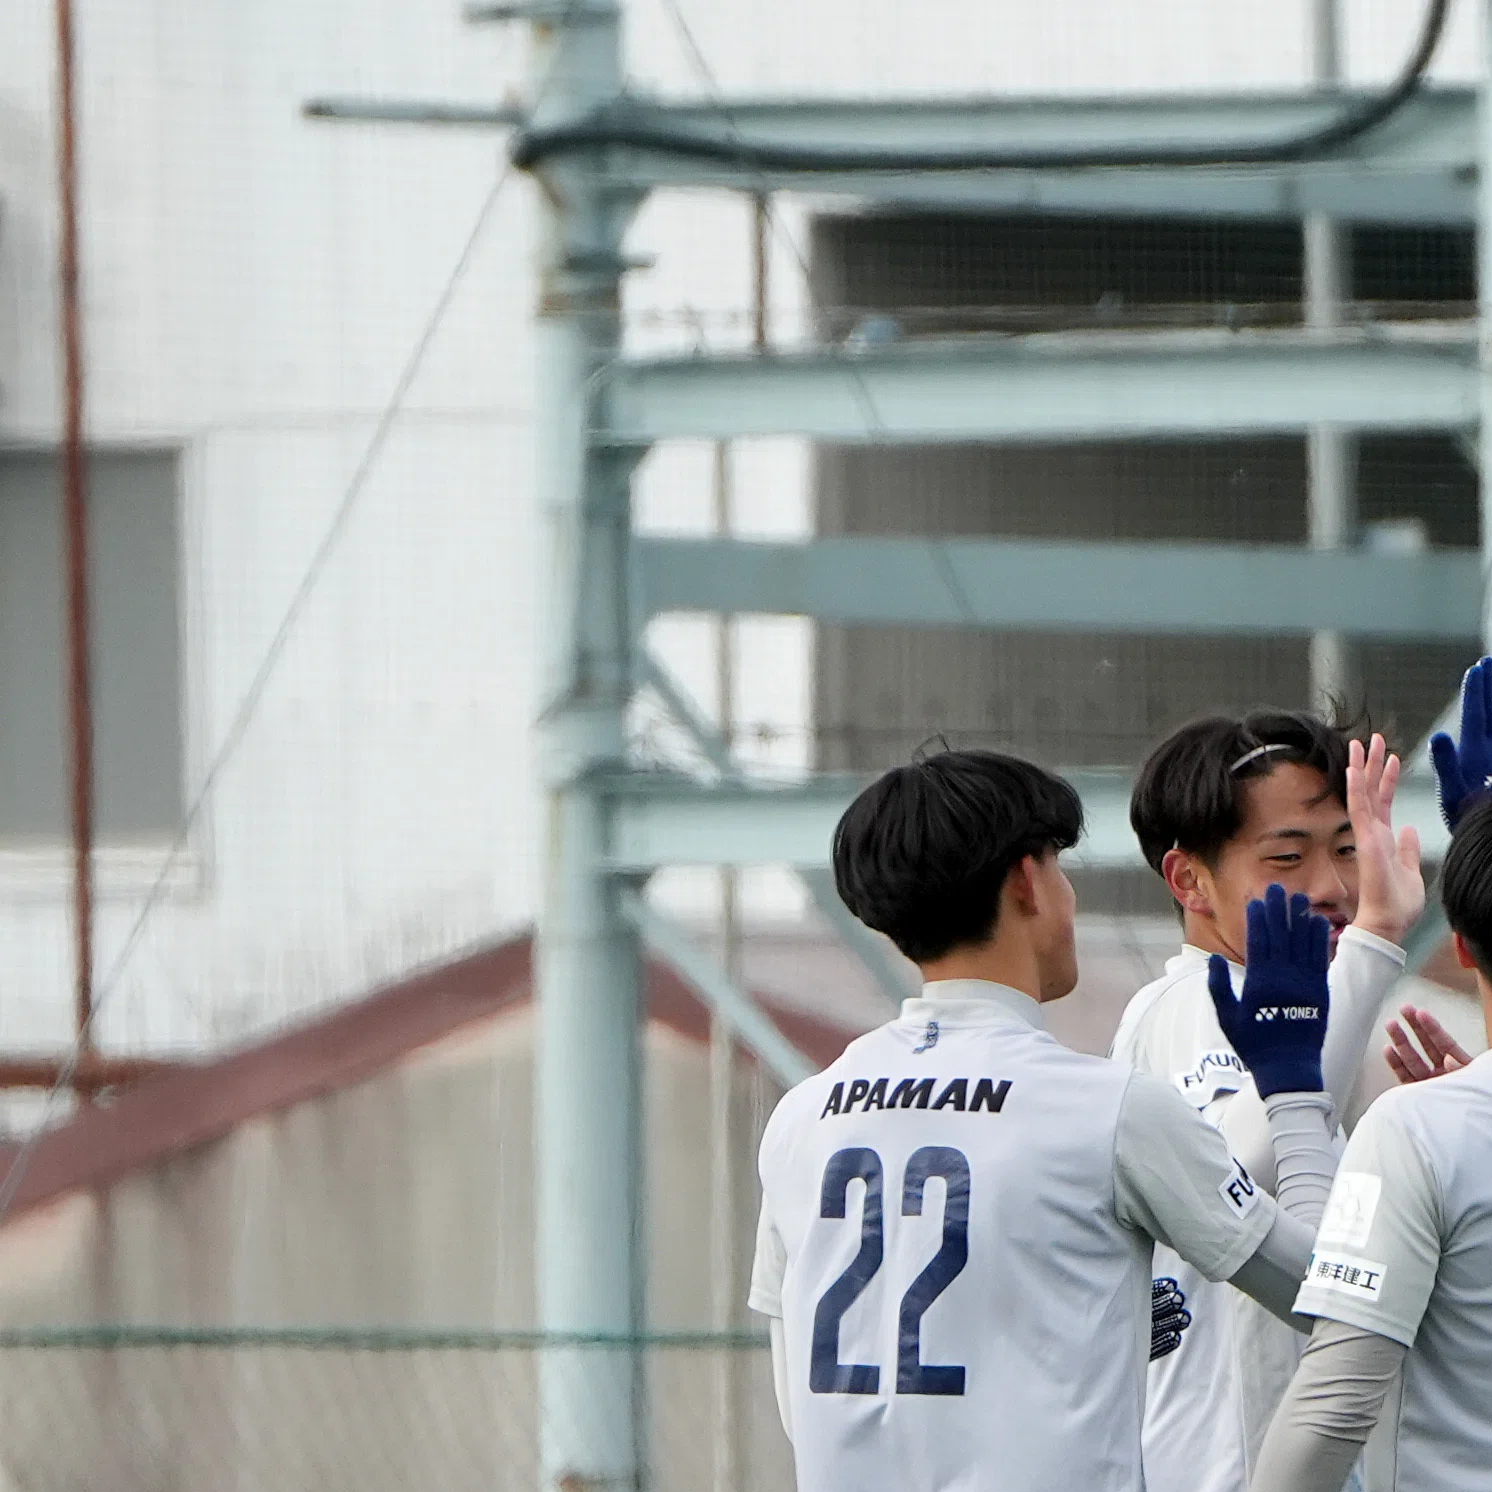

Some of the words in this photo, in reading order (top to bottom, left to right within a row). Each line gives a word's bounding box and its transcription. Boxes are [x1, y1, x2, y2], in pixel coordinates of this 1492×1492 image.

[1281, 1006, 1320, 1020] YONEX
[819, 1077, 1014, 1121] APAMAN
[808, 1145, 972, 1397] 22
